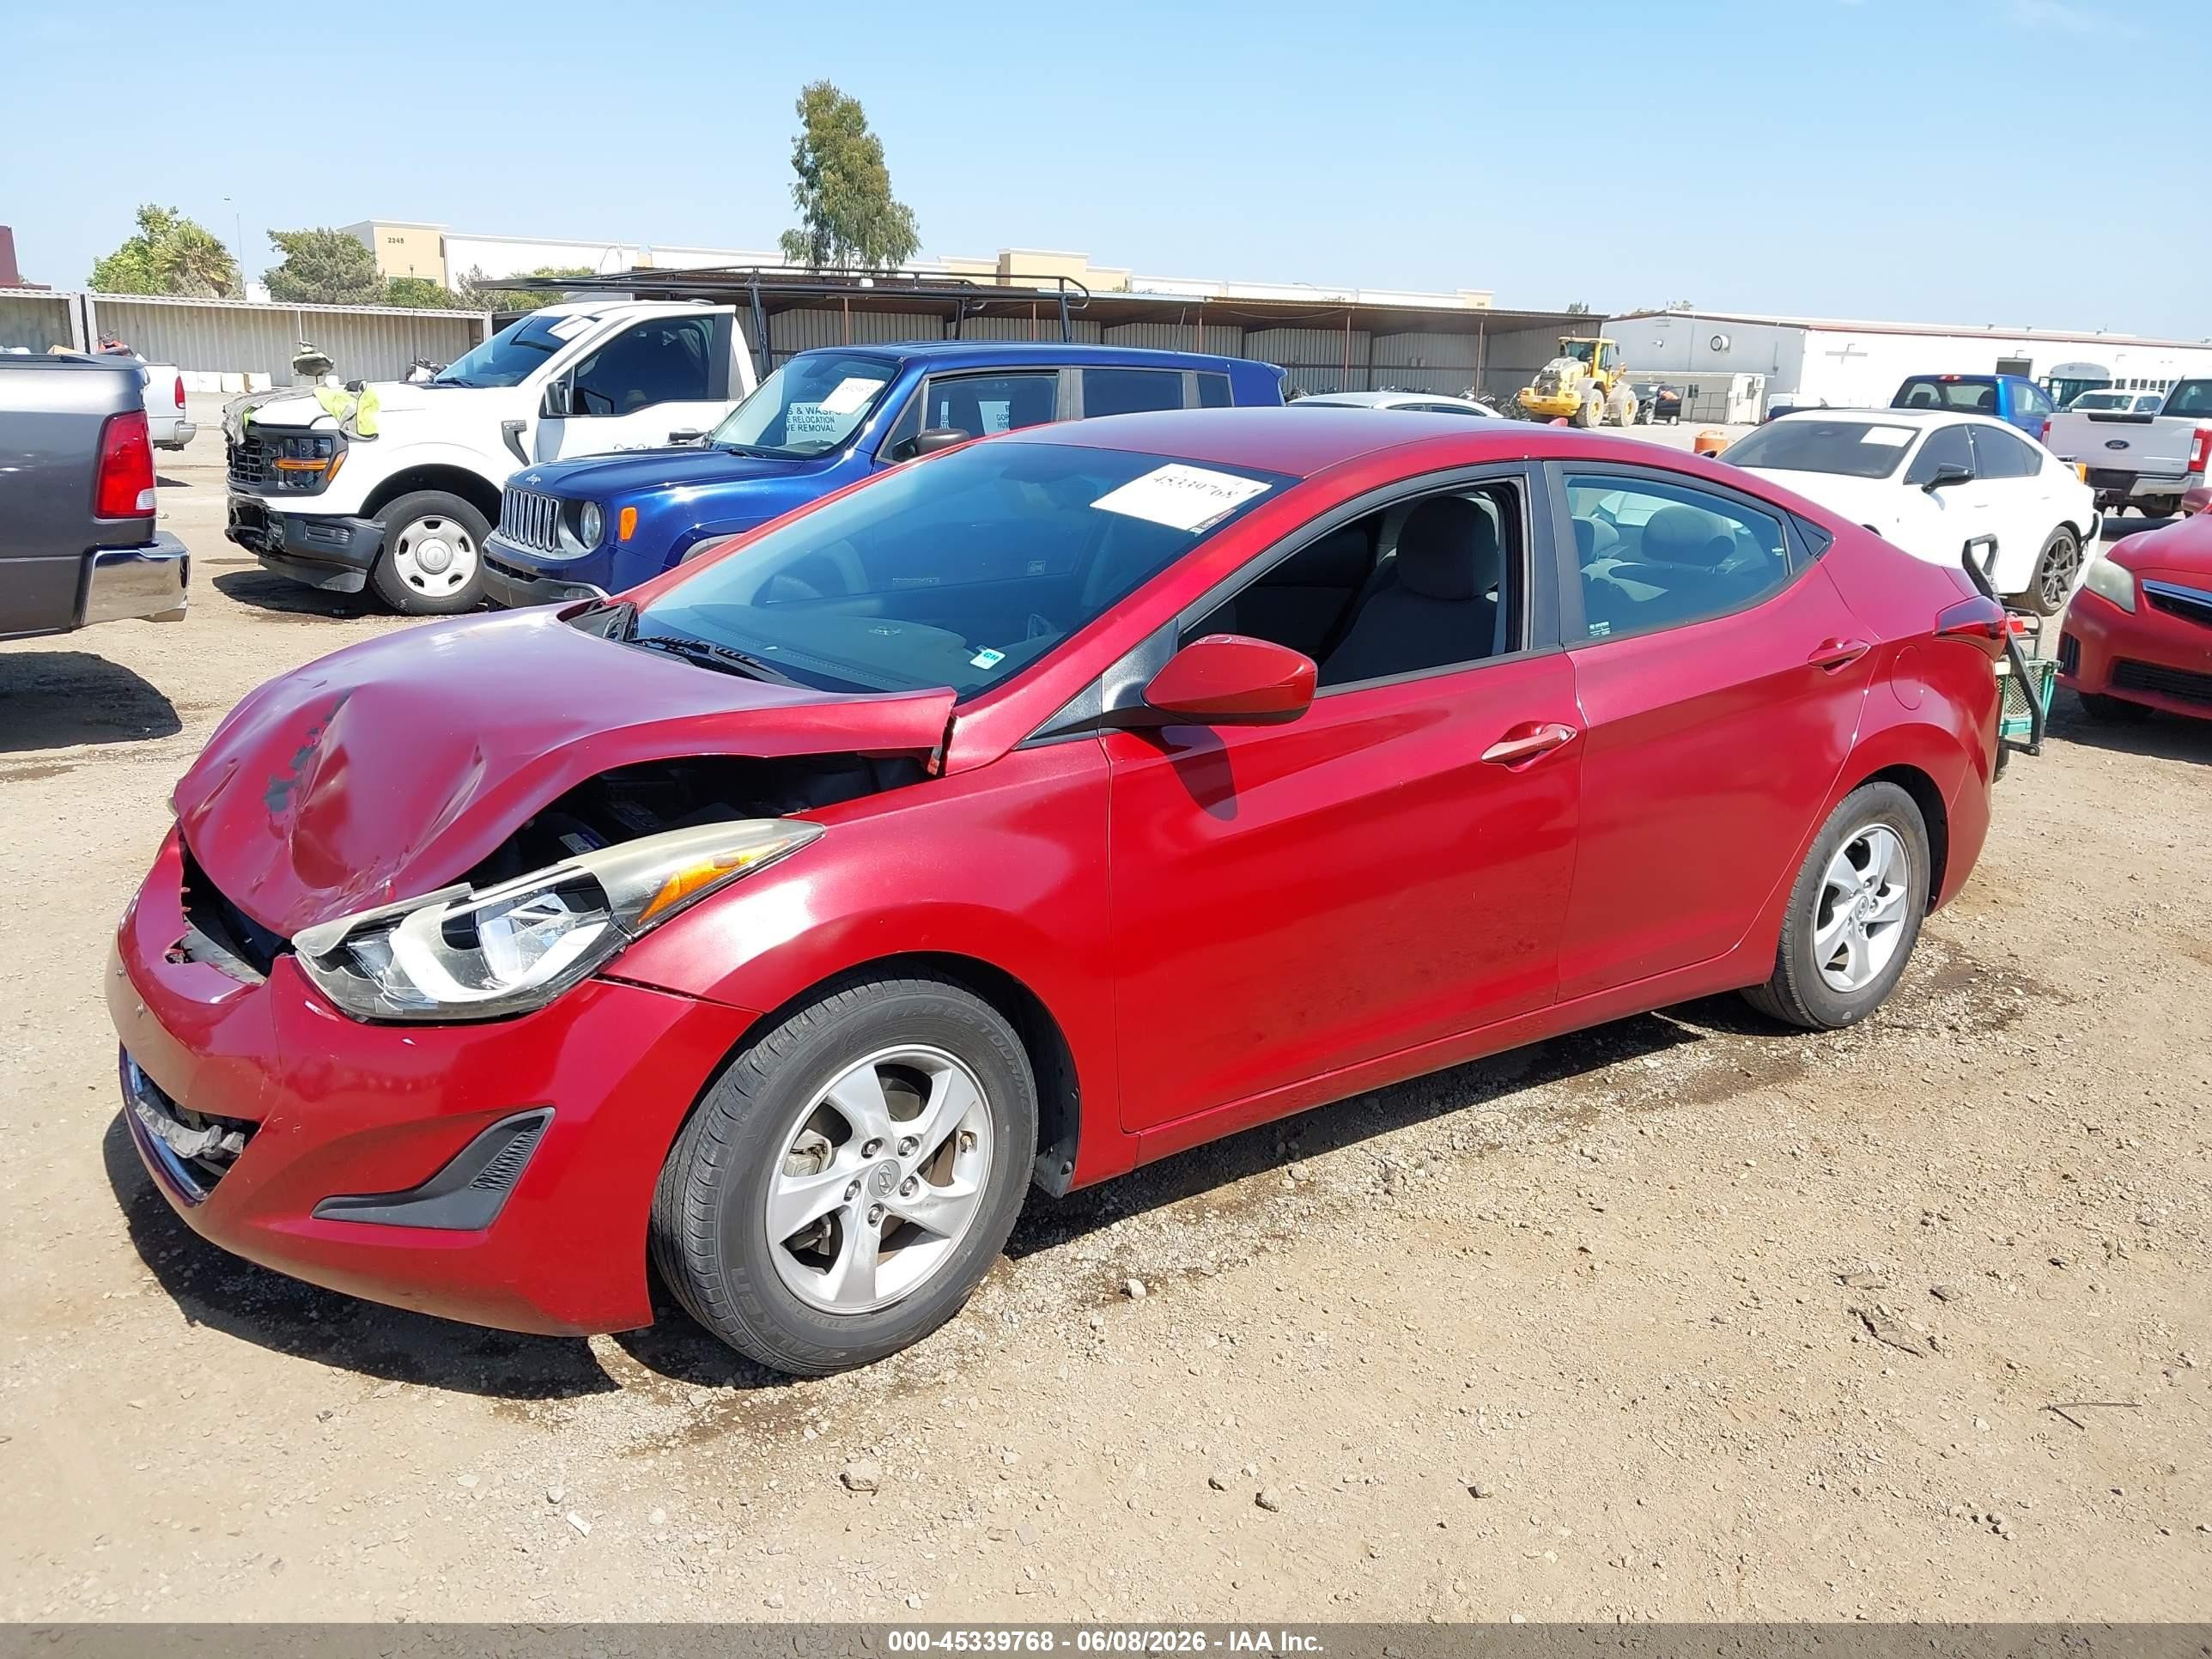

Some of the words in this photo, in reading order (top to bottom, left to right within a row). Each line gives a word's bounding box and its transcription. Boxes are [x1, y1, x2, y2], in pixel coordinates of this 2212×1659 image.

[797, 407, 804, 416] &
[793, 416, 836, 424] RELOCATION
[798, 424, 836, 433] REMOVAL
